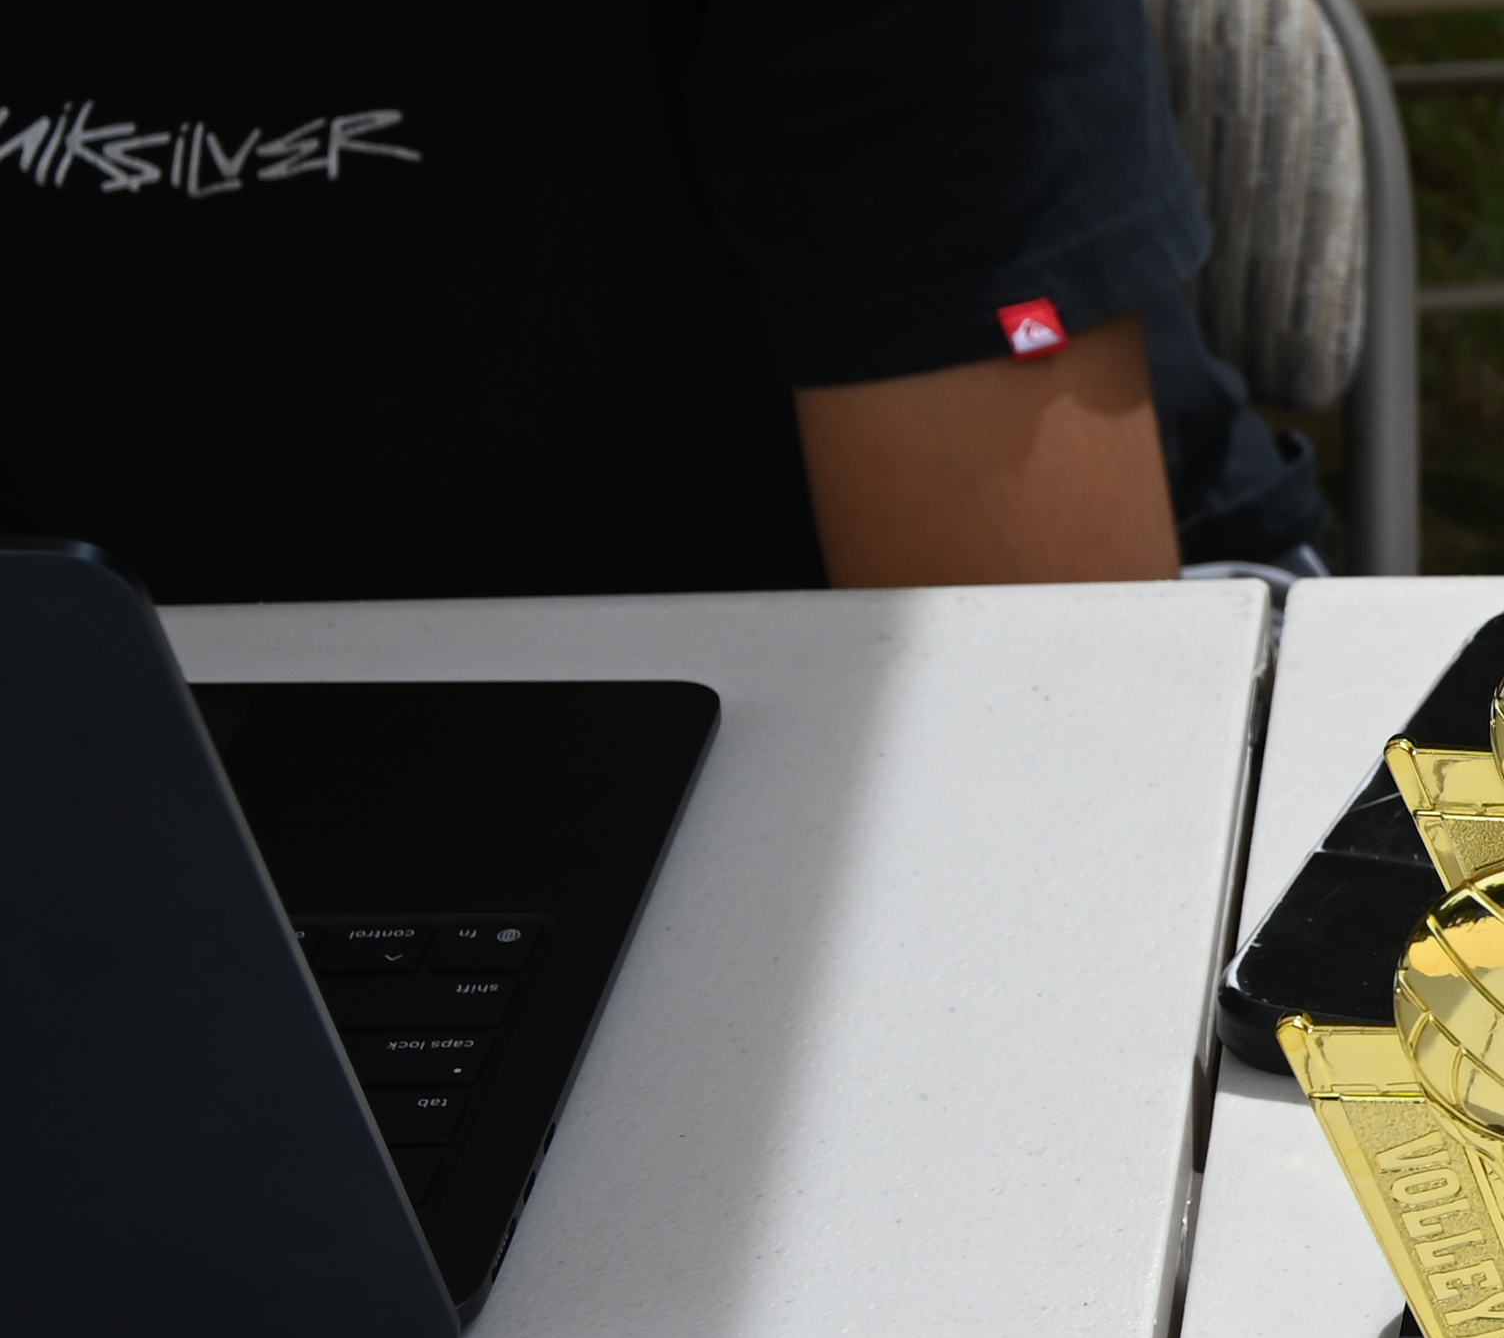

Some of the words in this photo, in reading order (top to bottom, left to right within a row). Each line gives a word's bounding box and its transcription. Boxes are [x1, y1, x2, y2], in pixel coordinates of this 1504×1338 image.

[349, 928, 415, 940] control
[459, 928, 477, 939] fn
[455, 983, 499, 994] shift
[387, 1039, 426, 1051] lock
[431, 1039, 475, 1050] caps
[417, 1097, 448, 1108] tab
